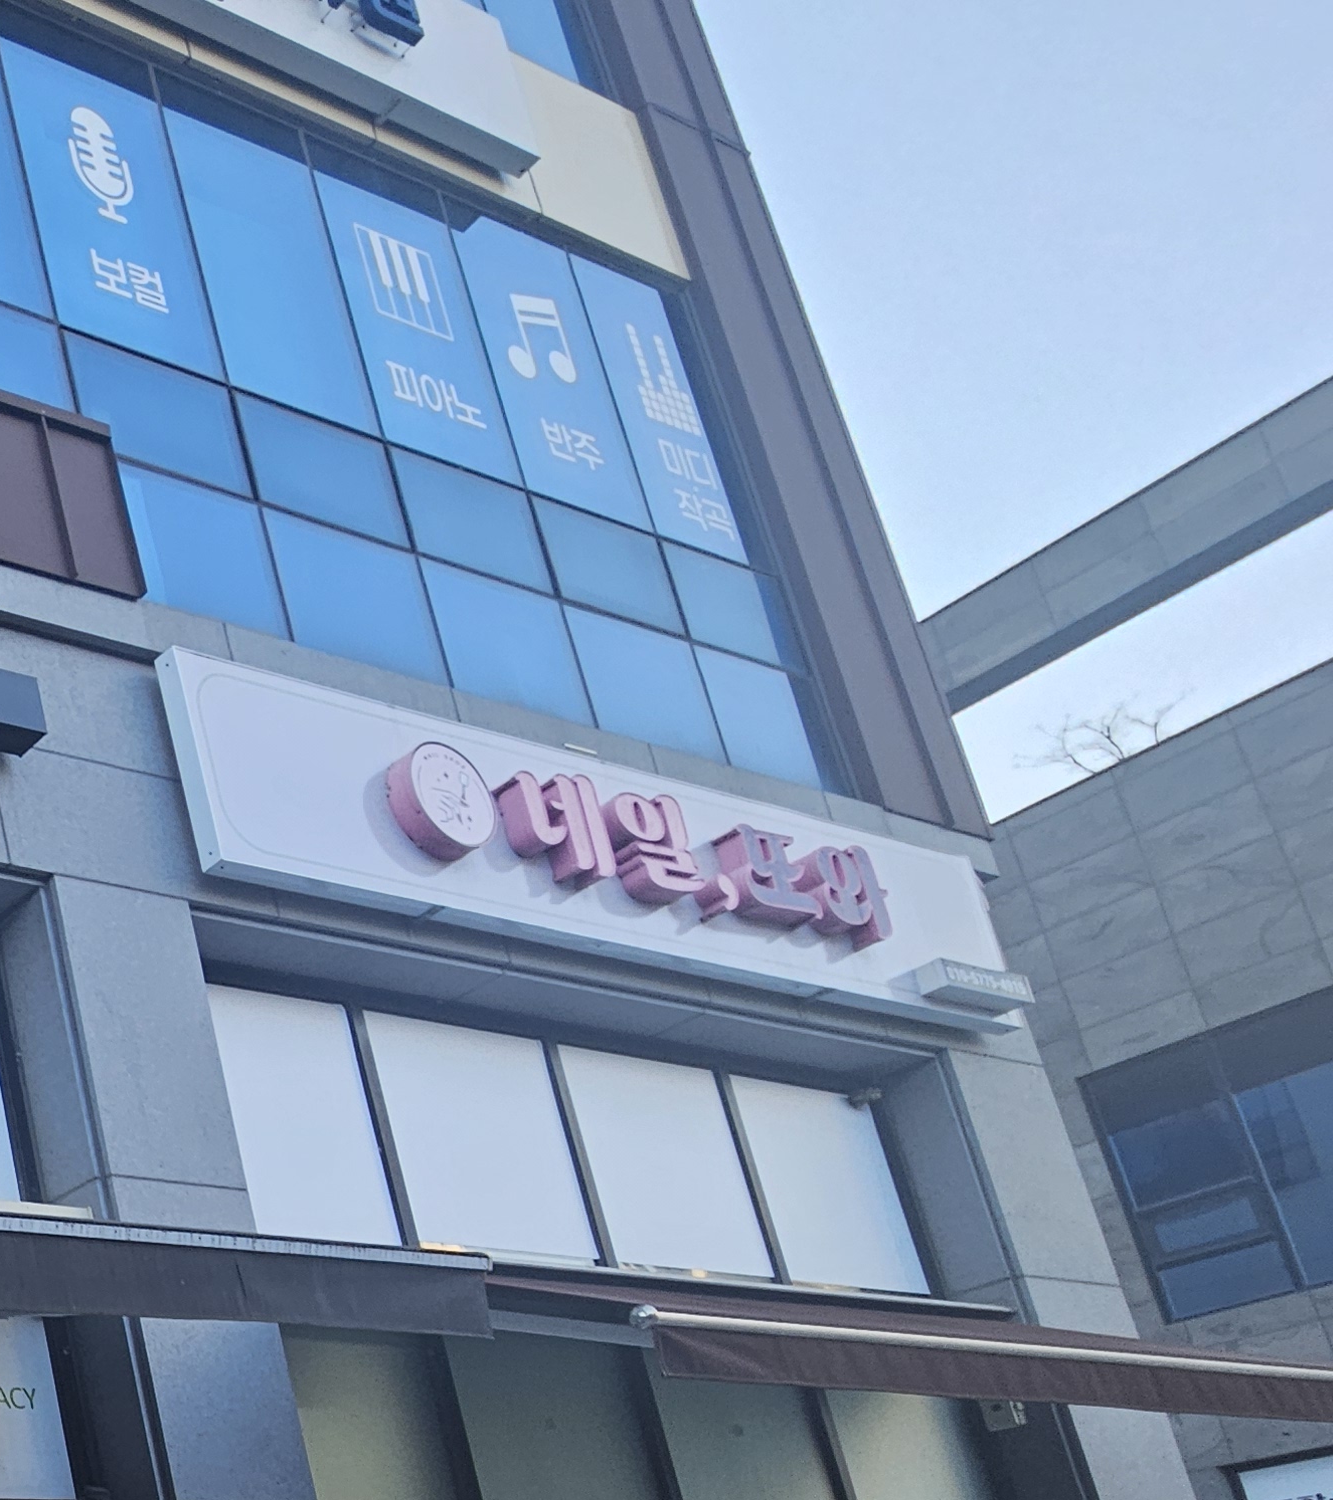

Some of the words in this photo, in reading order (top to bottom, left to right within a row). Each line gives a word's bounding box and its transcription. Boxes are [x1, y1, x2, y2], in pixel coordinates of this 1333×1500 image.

[90, 248, 169, 314] 보컬
[385, 359, 488, 430] 피아노
[540, 416, 604, 471] 반주
[658, 438, 718, 490] 미디
[673, 486, 735, 542] 작곡
